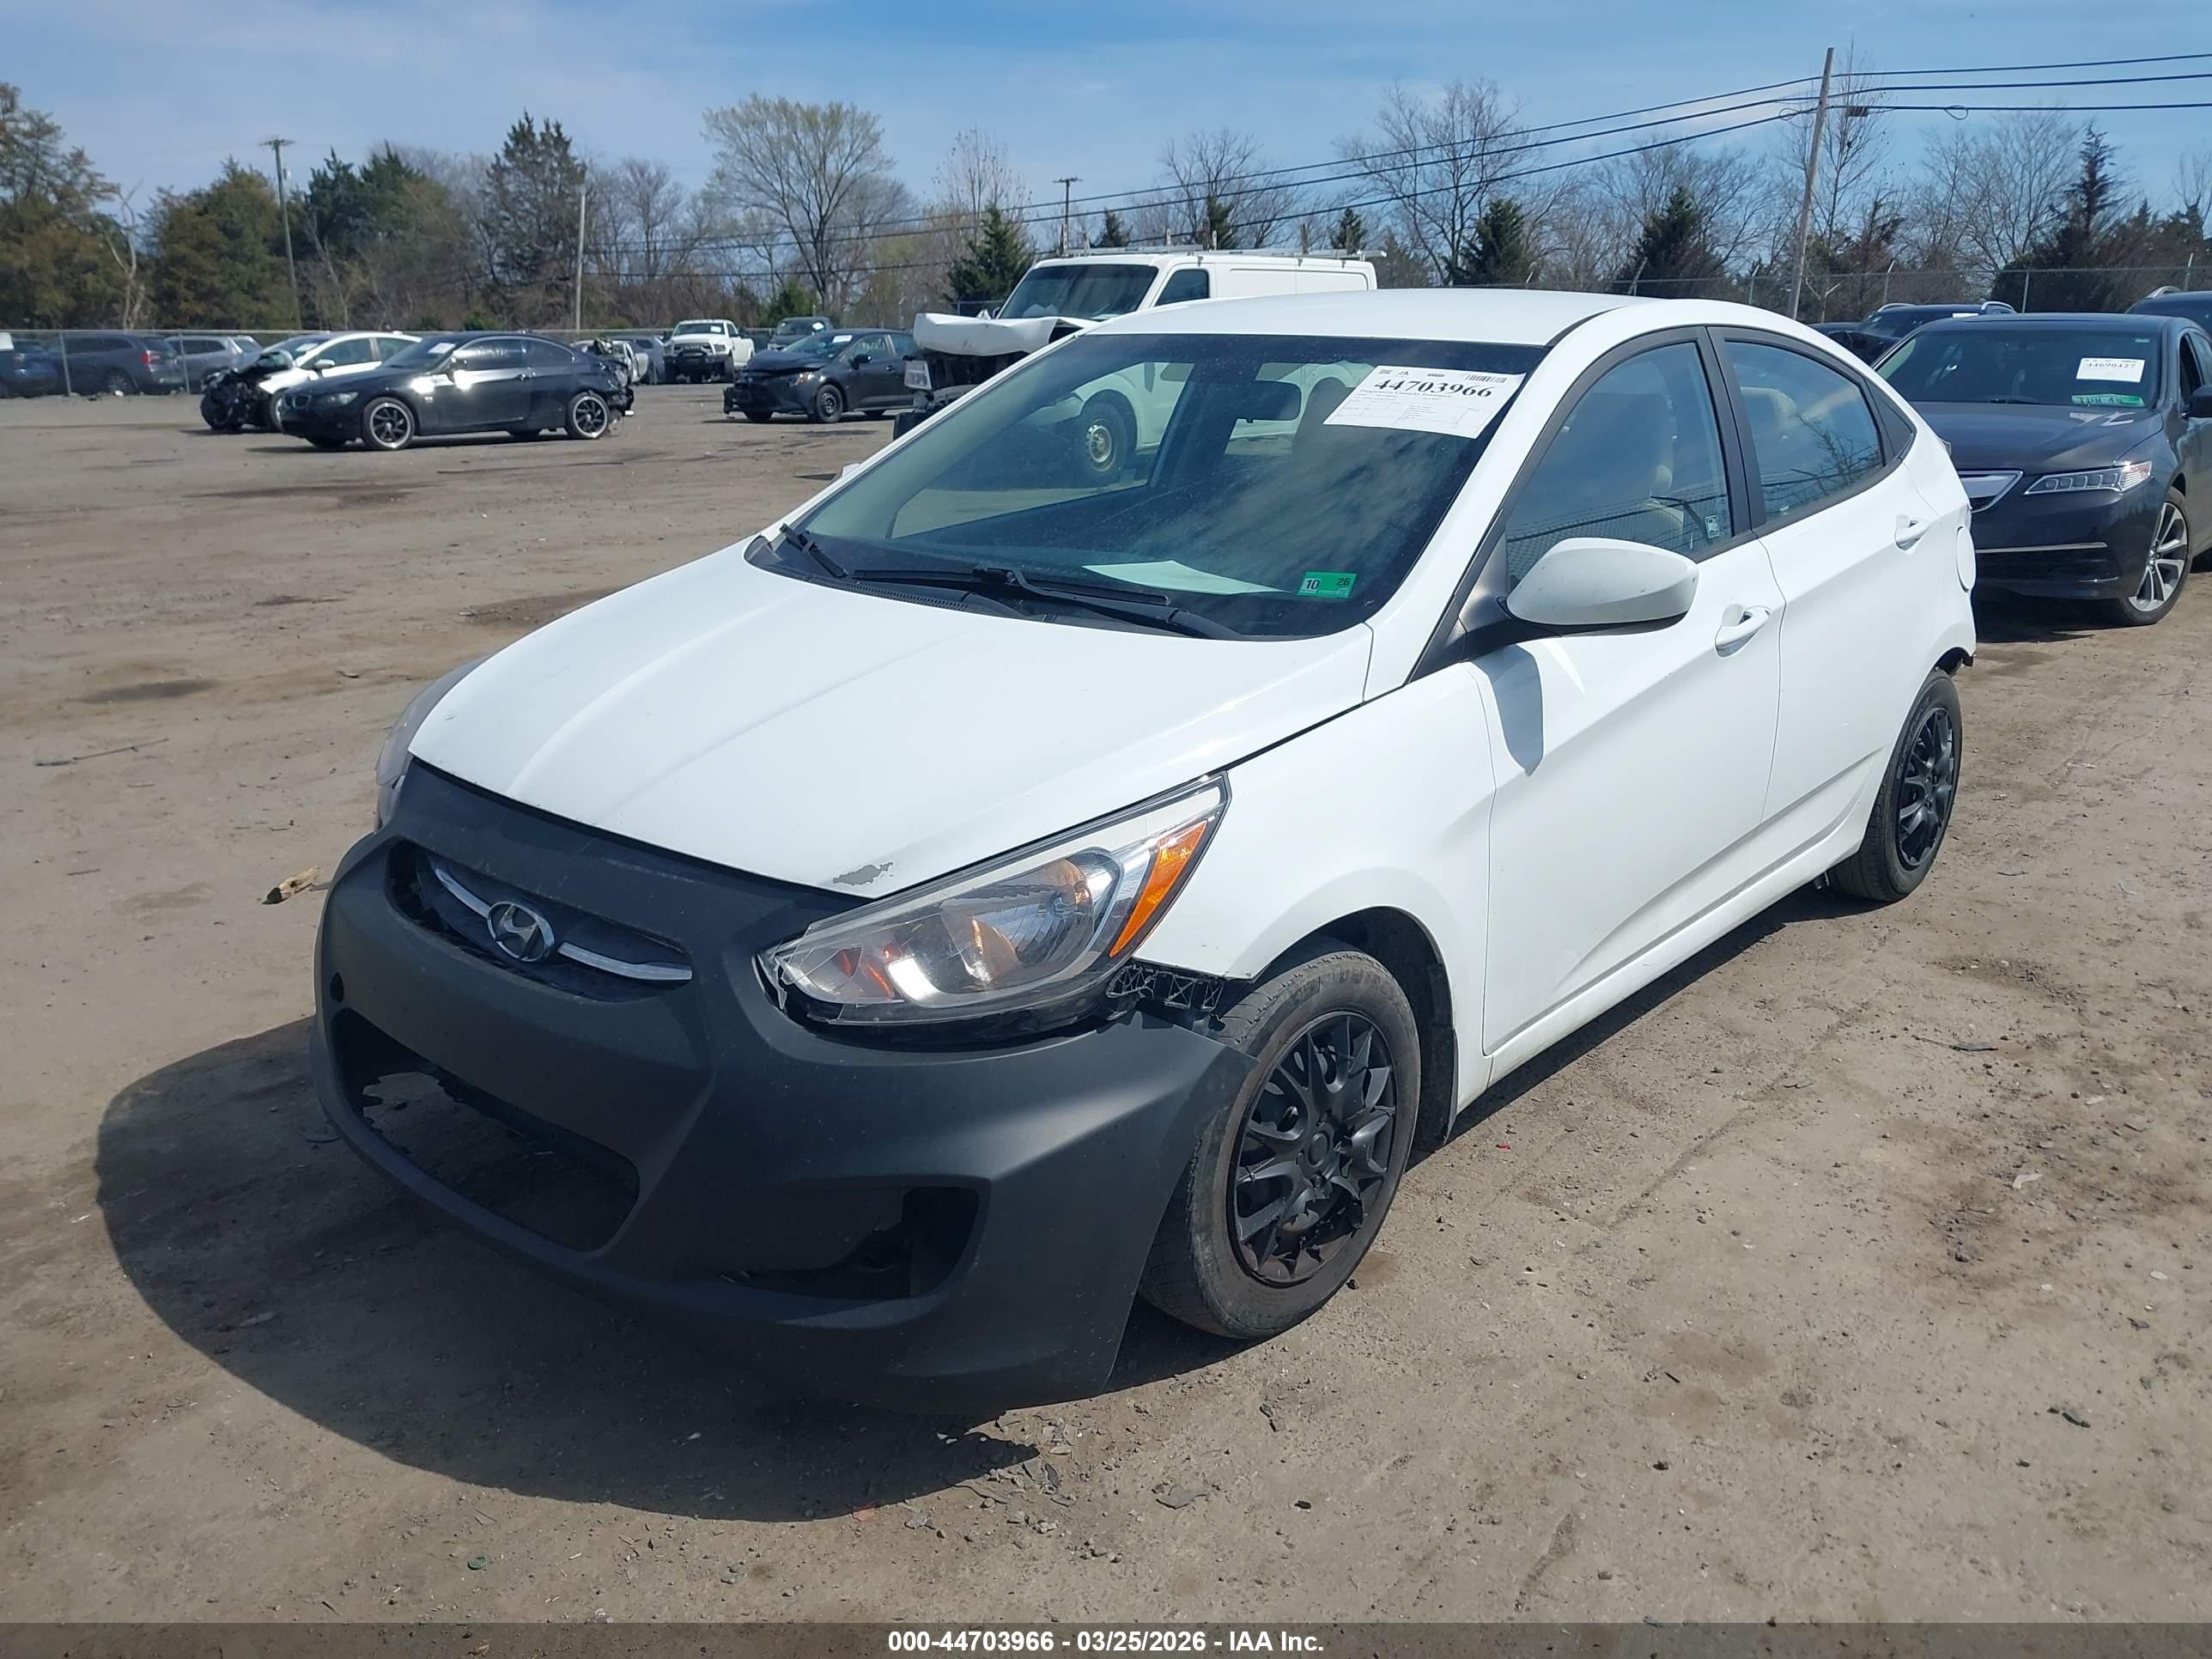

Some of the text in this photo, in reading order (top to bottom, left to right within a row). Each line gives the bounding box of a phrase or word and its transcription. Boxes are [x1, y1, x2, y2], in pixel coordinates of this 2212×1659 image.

[1375, 379, 1497, 398] 44703966
[1306, 578, 1352, 590] 10 26
